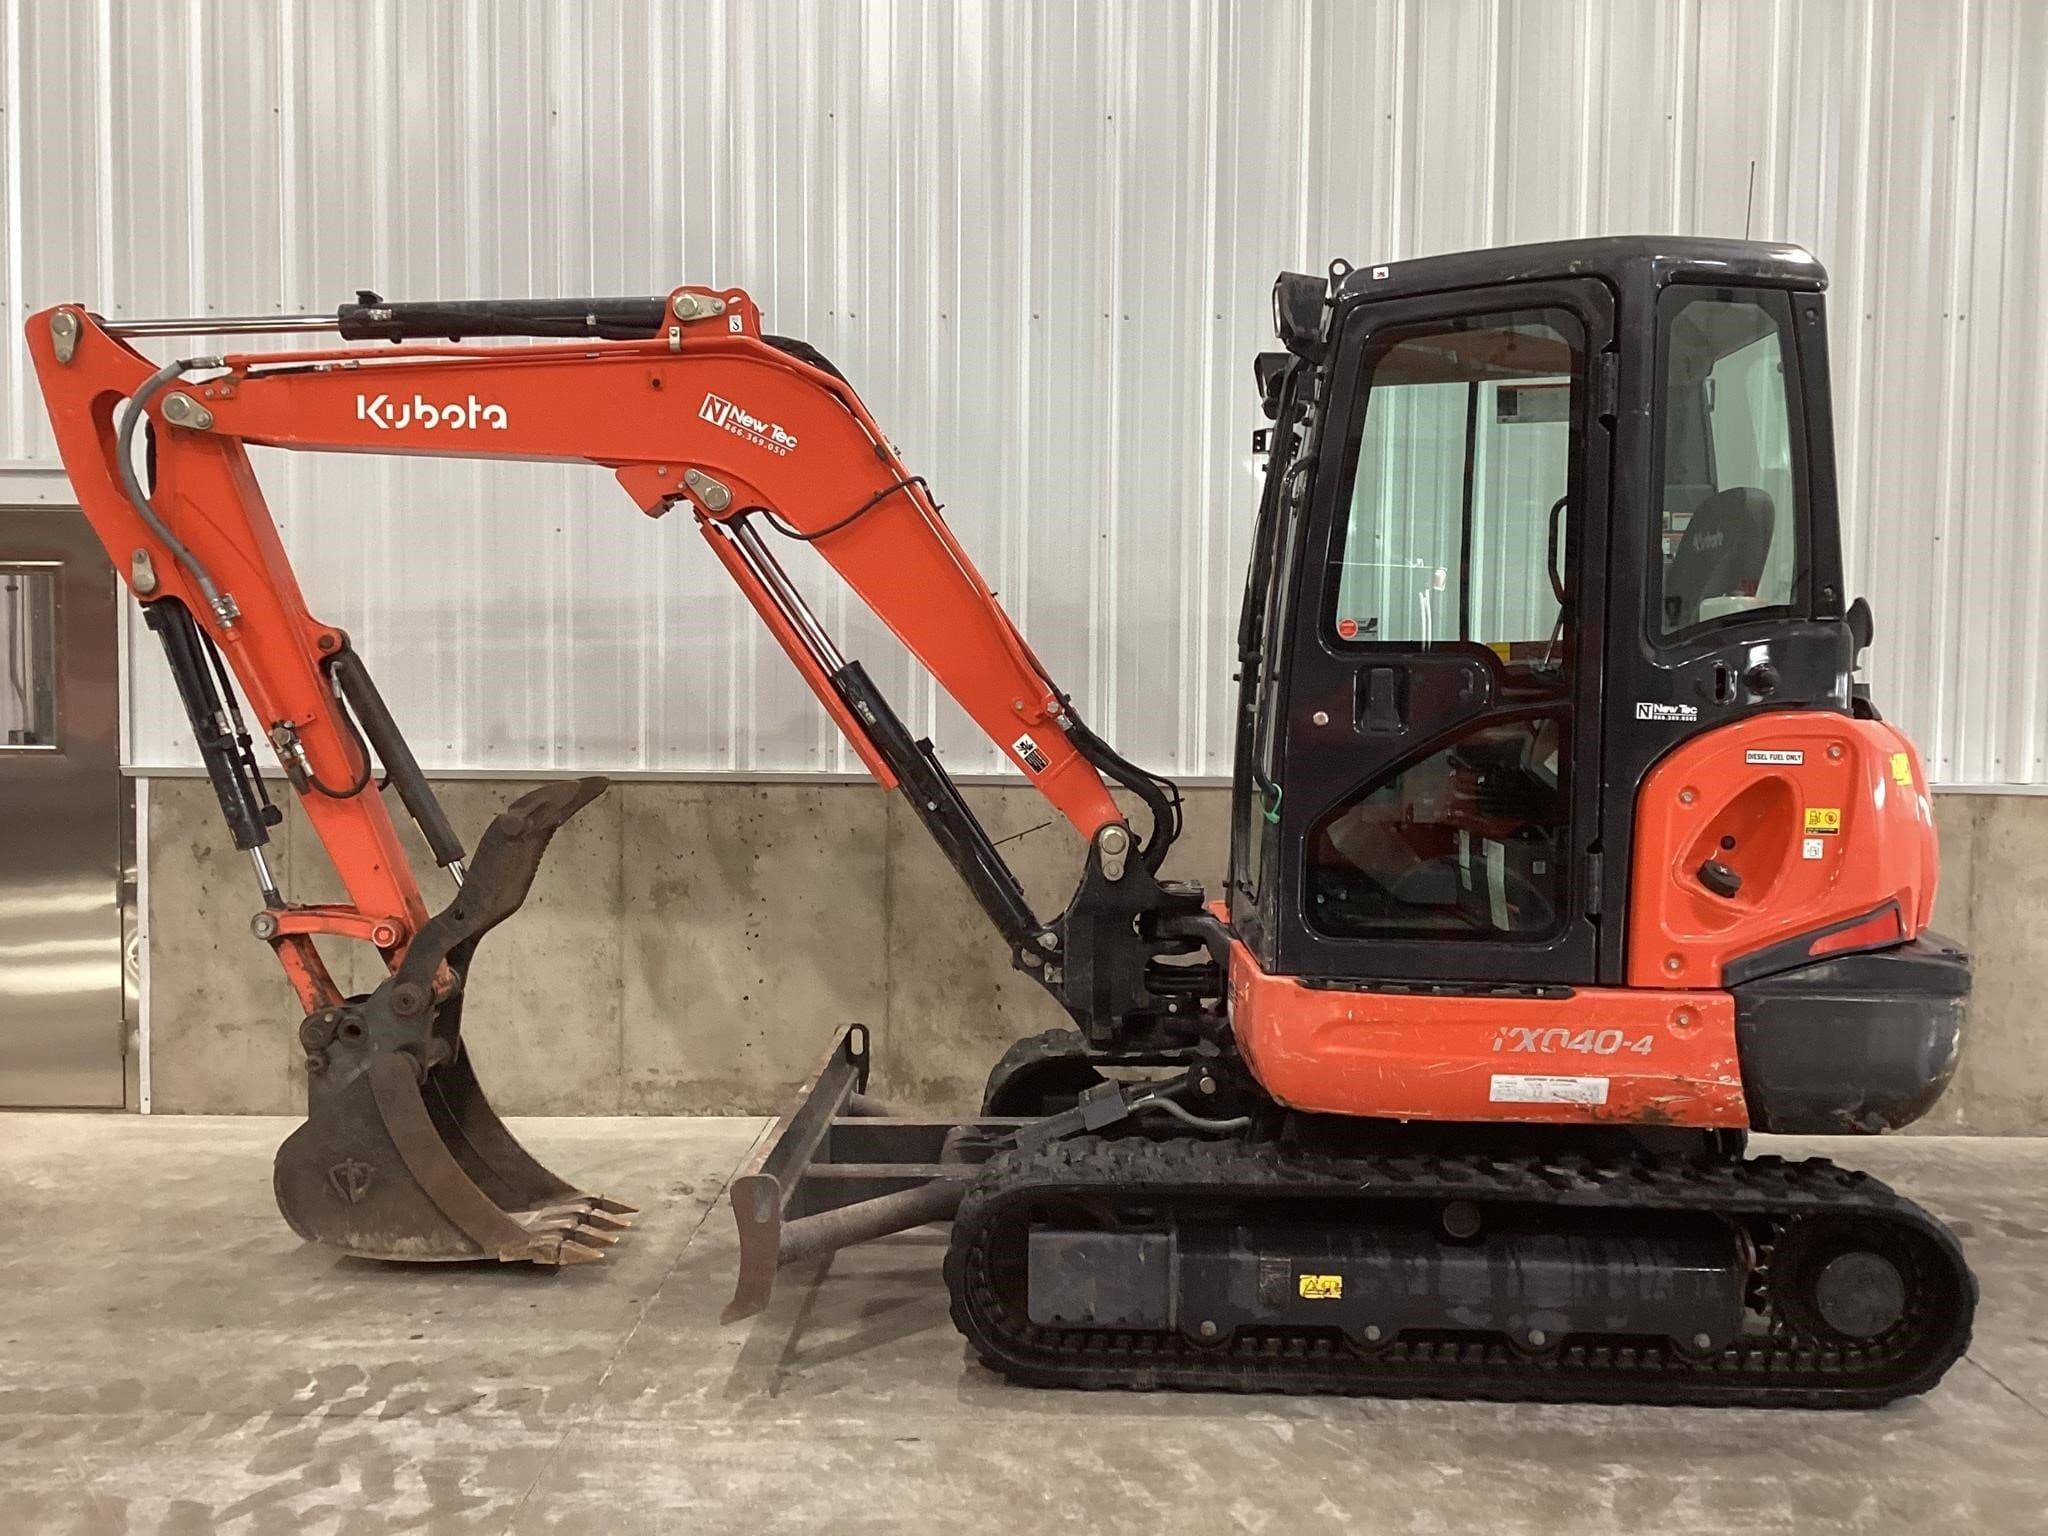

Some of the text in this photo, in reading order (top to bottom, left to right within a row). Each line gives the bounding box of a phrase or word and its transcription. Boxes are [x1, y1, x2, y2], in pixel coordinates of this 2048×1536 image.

[356, 394, 508, 430] Kubota
[728, 405, 769, 433] New
[770, 423, 798, 448] Tec
[1653, 703, 1679, 714] New
[1679, 704, 1698, 715] Tec
[1747, 753, 1768, 761] DIESEL
[1769, 753, 1785, 761] FUEL
